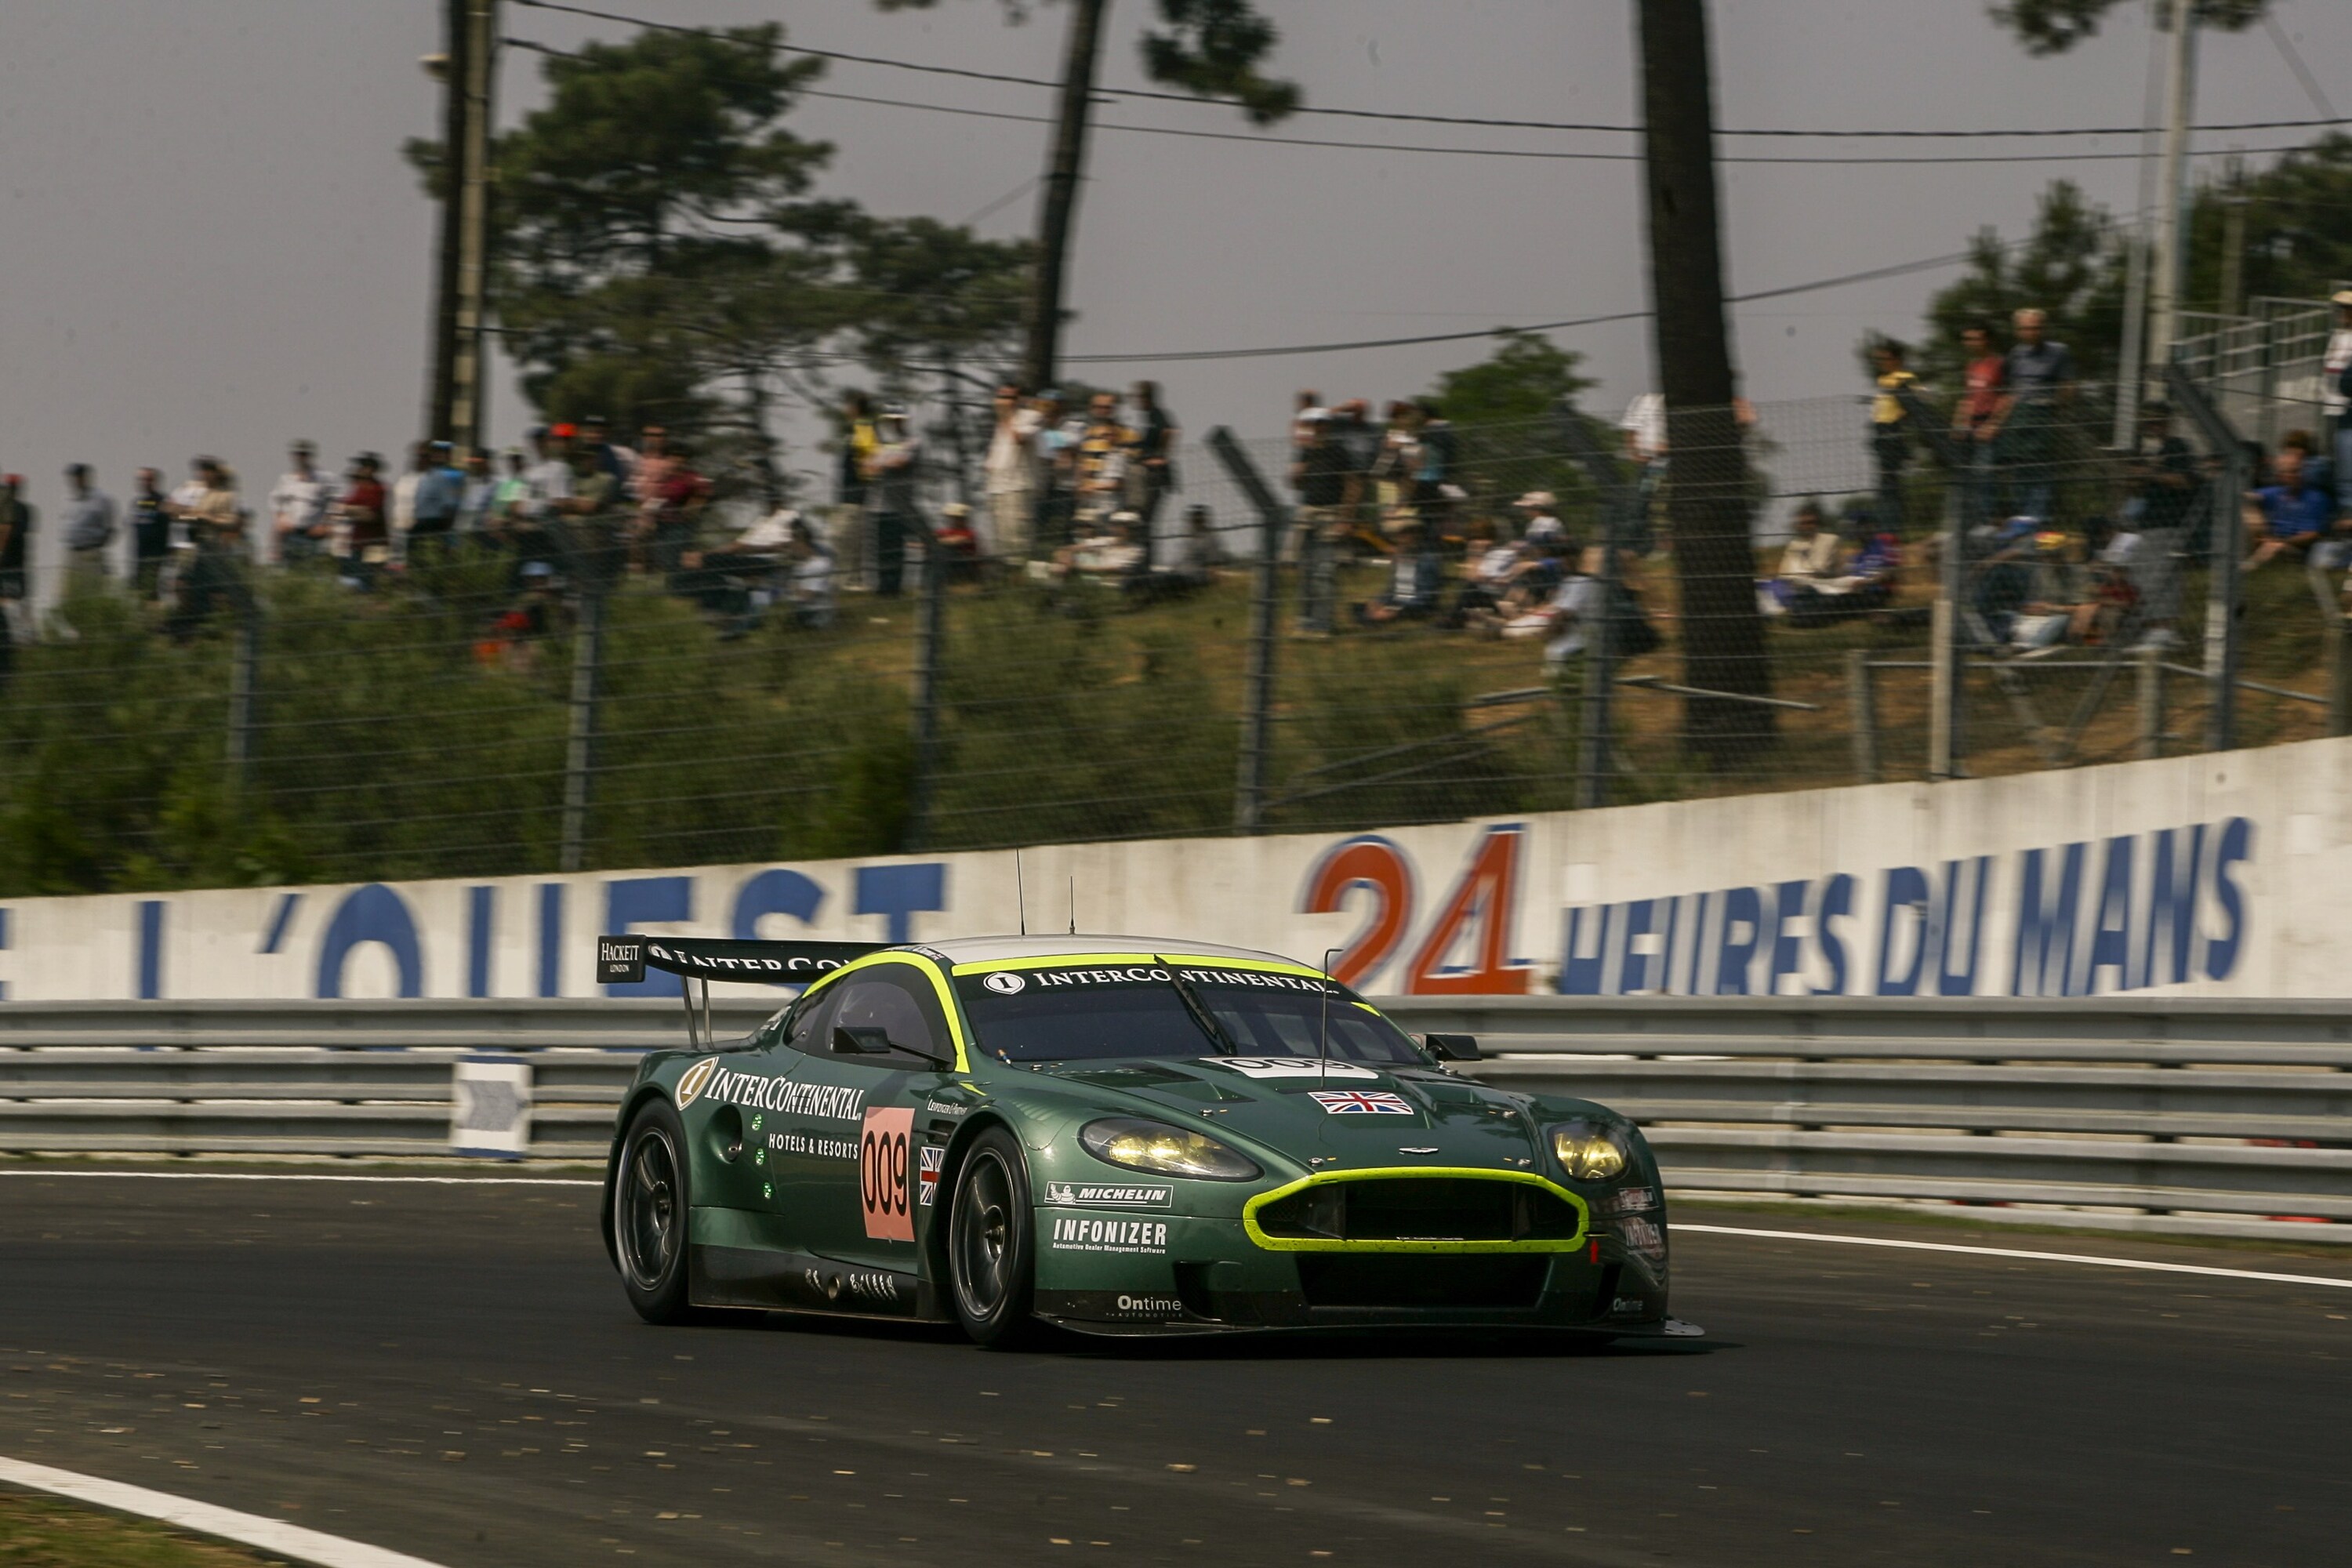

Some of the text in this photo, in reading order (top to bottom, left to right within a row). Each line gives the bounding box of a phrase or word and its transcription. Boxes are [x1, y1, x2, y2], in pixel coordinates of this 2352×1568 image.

[1305, 817, 2255, 996] 24 HEURES DU MANS
[601, 942, 640, 961] HACKETT
[610, 964, 630, 973] LONDON
[1033, 968, 1335, 993] INTERCONTINENTAL
[1222, 1059, 1354, 1069] 009
[705, 1067, 864, 1120] INTERCONTINENTAL
[769, 1134, 858, 1160] HOTELS & RESORTS
[862, 1131, 908, 1217] 009
[1079, 1188, 1167, 1200] MICHELIN
[1053, 1218, 1167, 1245] INFONIZER
[1104, 1245, 1139, 1254] Management
[1117, 1295, 1181, 1310] Ontime
